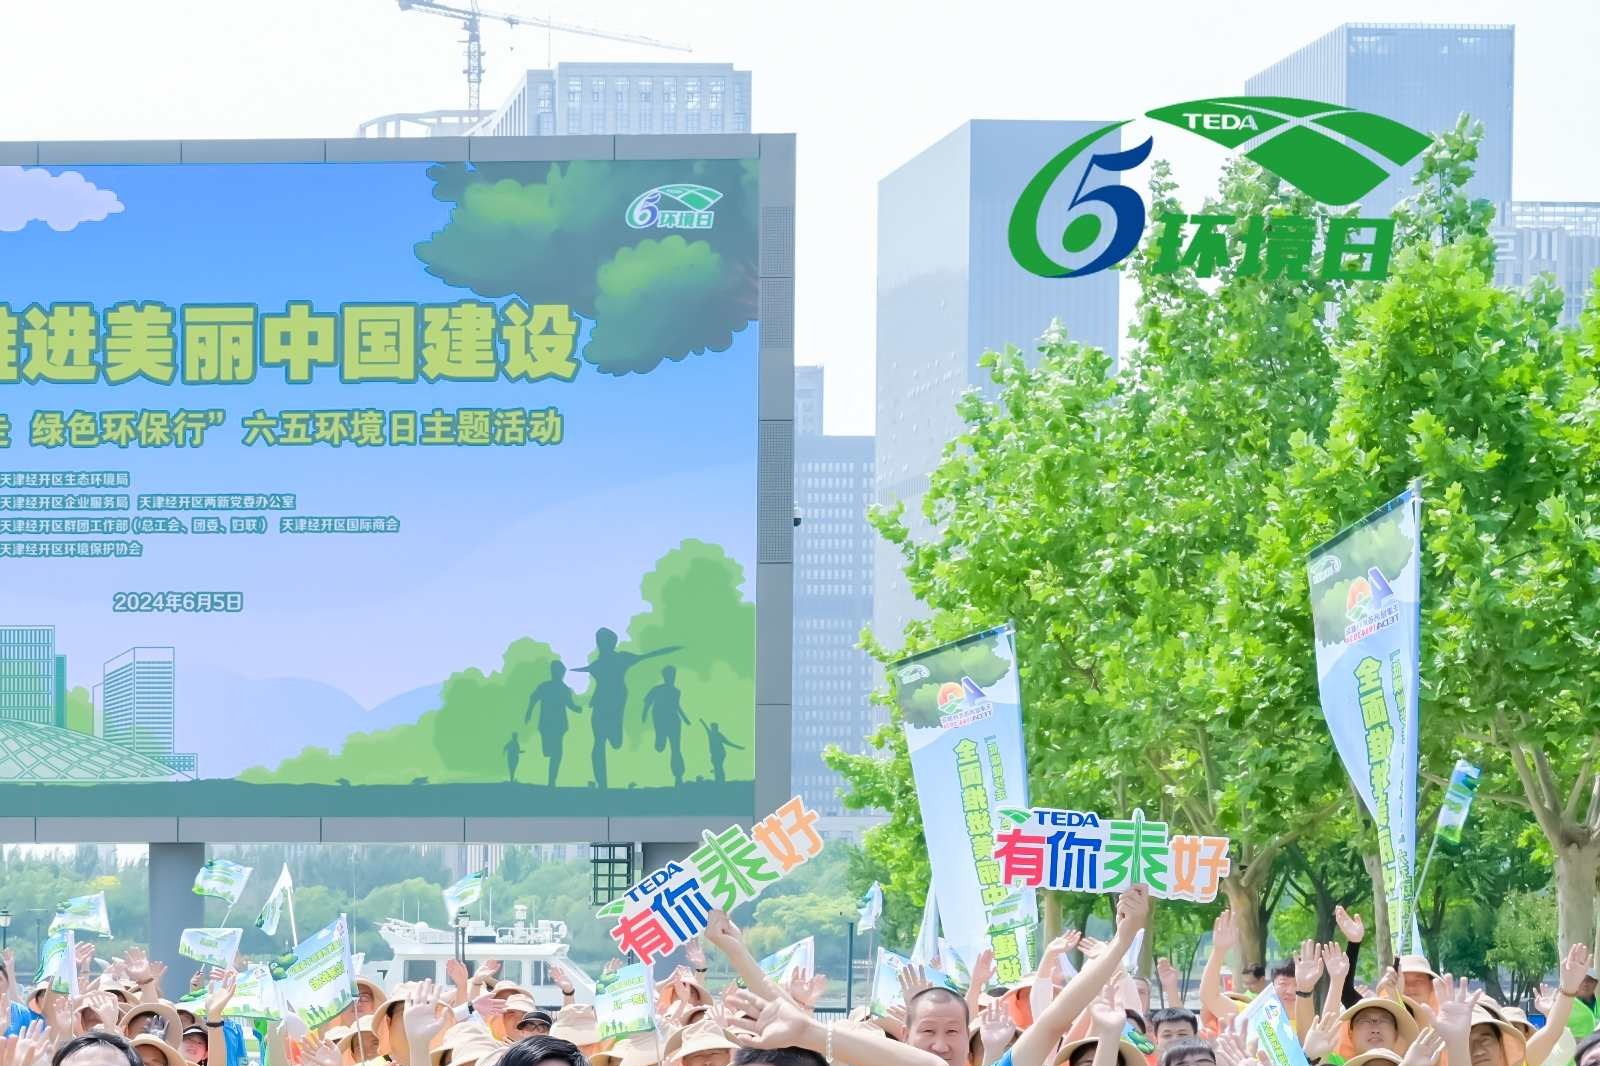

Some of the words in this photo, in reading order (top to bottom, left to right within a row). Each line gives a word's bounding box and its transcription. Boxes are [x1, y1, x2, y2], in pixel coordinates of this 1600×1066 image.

[242, 407, 564, 447] 六五环境日主题活动
[138, 494, 296, 510] 天津经开区两新党委办公室
[280, 516, 400, 533] 天津经开区国际商会
[112, 592, 243, 612] 2024年6月5日
[1033, 810, 1100, 828] TEDA
[994, 809, 1230, 895] 有你泰好
[623, 861, 684, 903] TEDA
